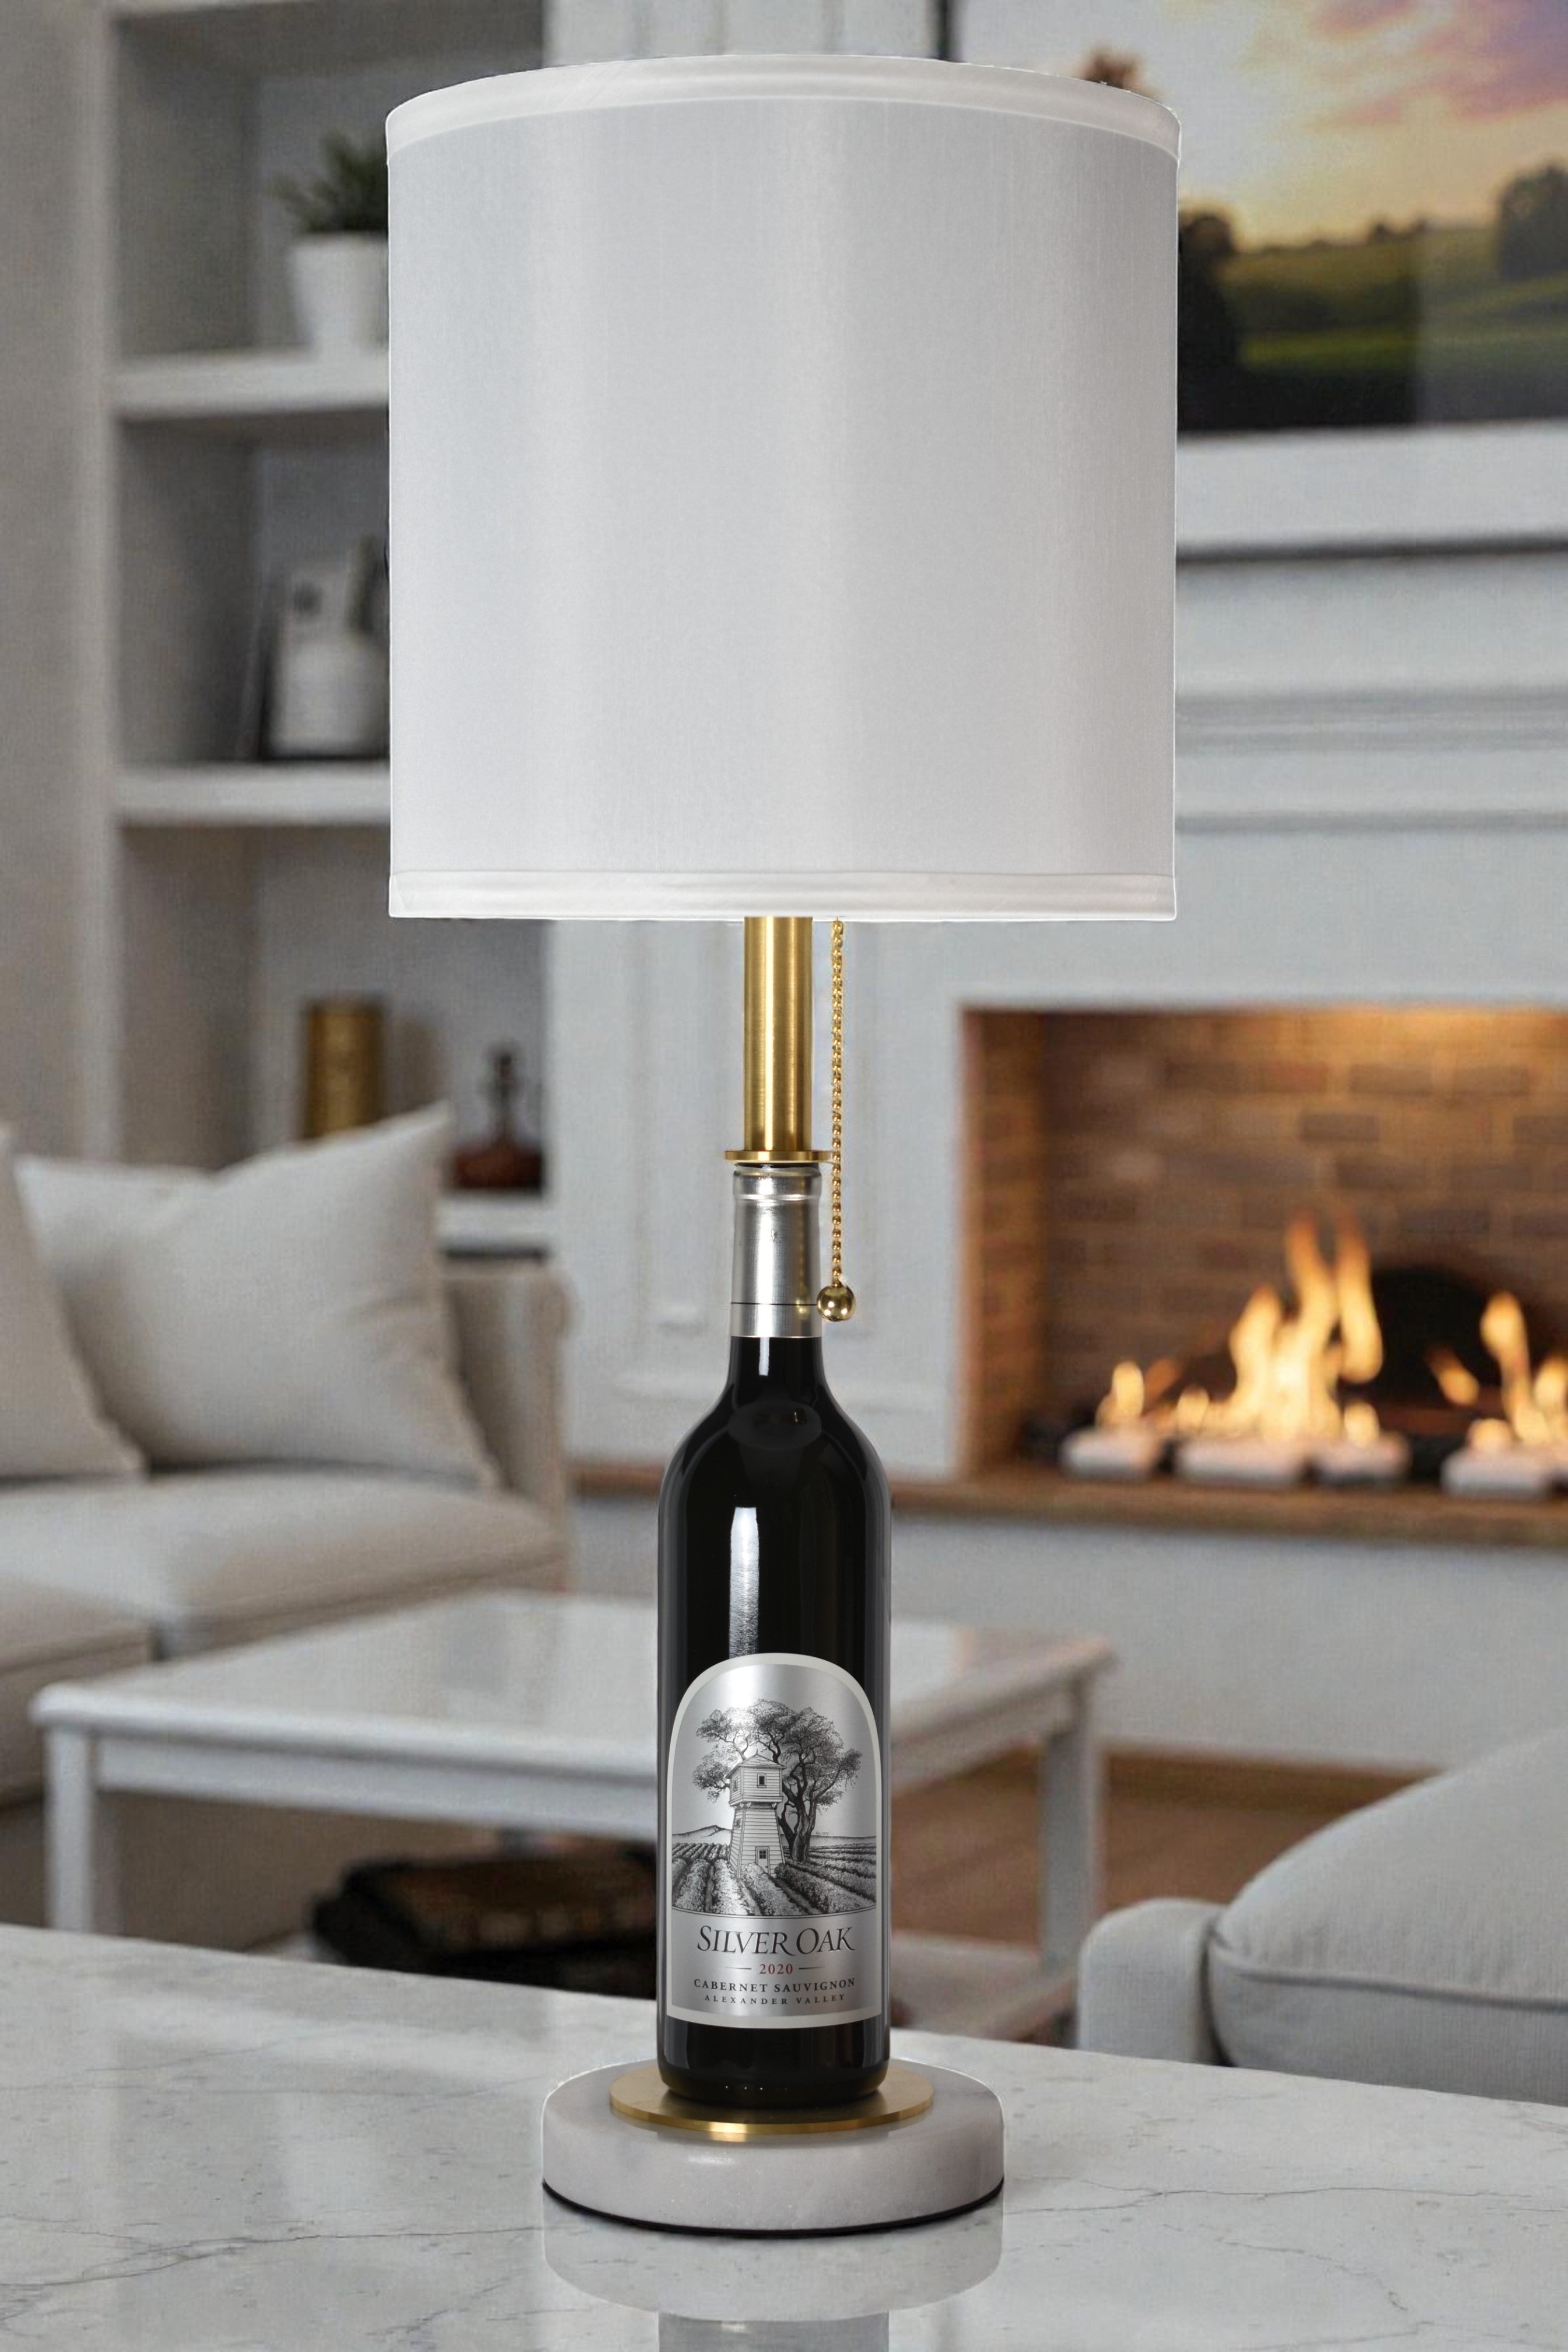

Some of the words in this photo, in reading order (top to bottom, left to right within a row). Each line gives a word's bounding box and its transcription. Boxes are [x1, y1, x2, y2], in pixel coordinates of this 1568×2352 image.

[698, 1926, 796, 1957] SILVER
[796, 1927, 855, 1954] OAK
[760, 1964, 793, 1975] 2020
[694, 1979, 768, 1993] CABERNET
[774, 1978, 855, 1993] SAUVIGNON
[705, 1995, 788, 2004] ALEXANDER
[796, 1994, 845, 2004] VALLEY
